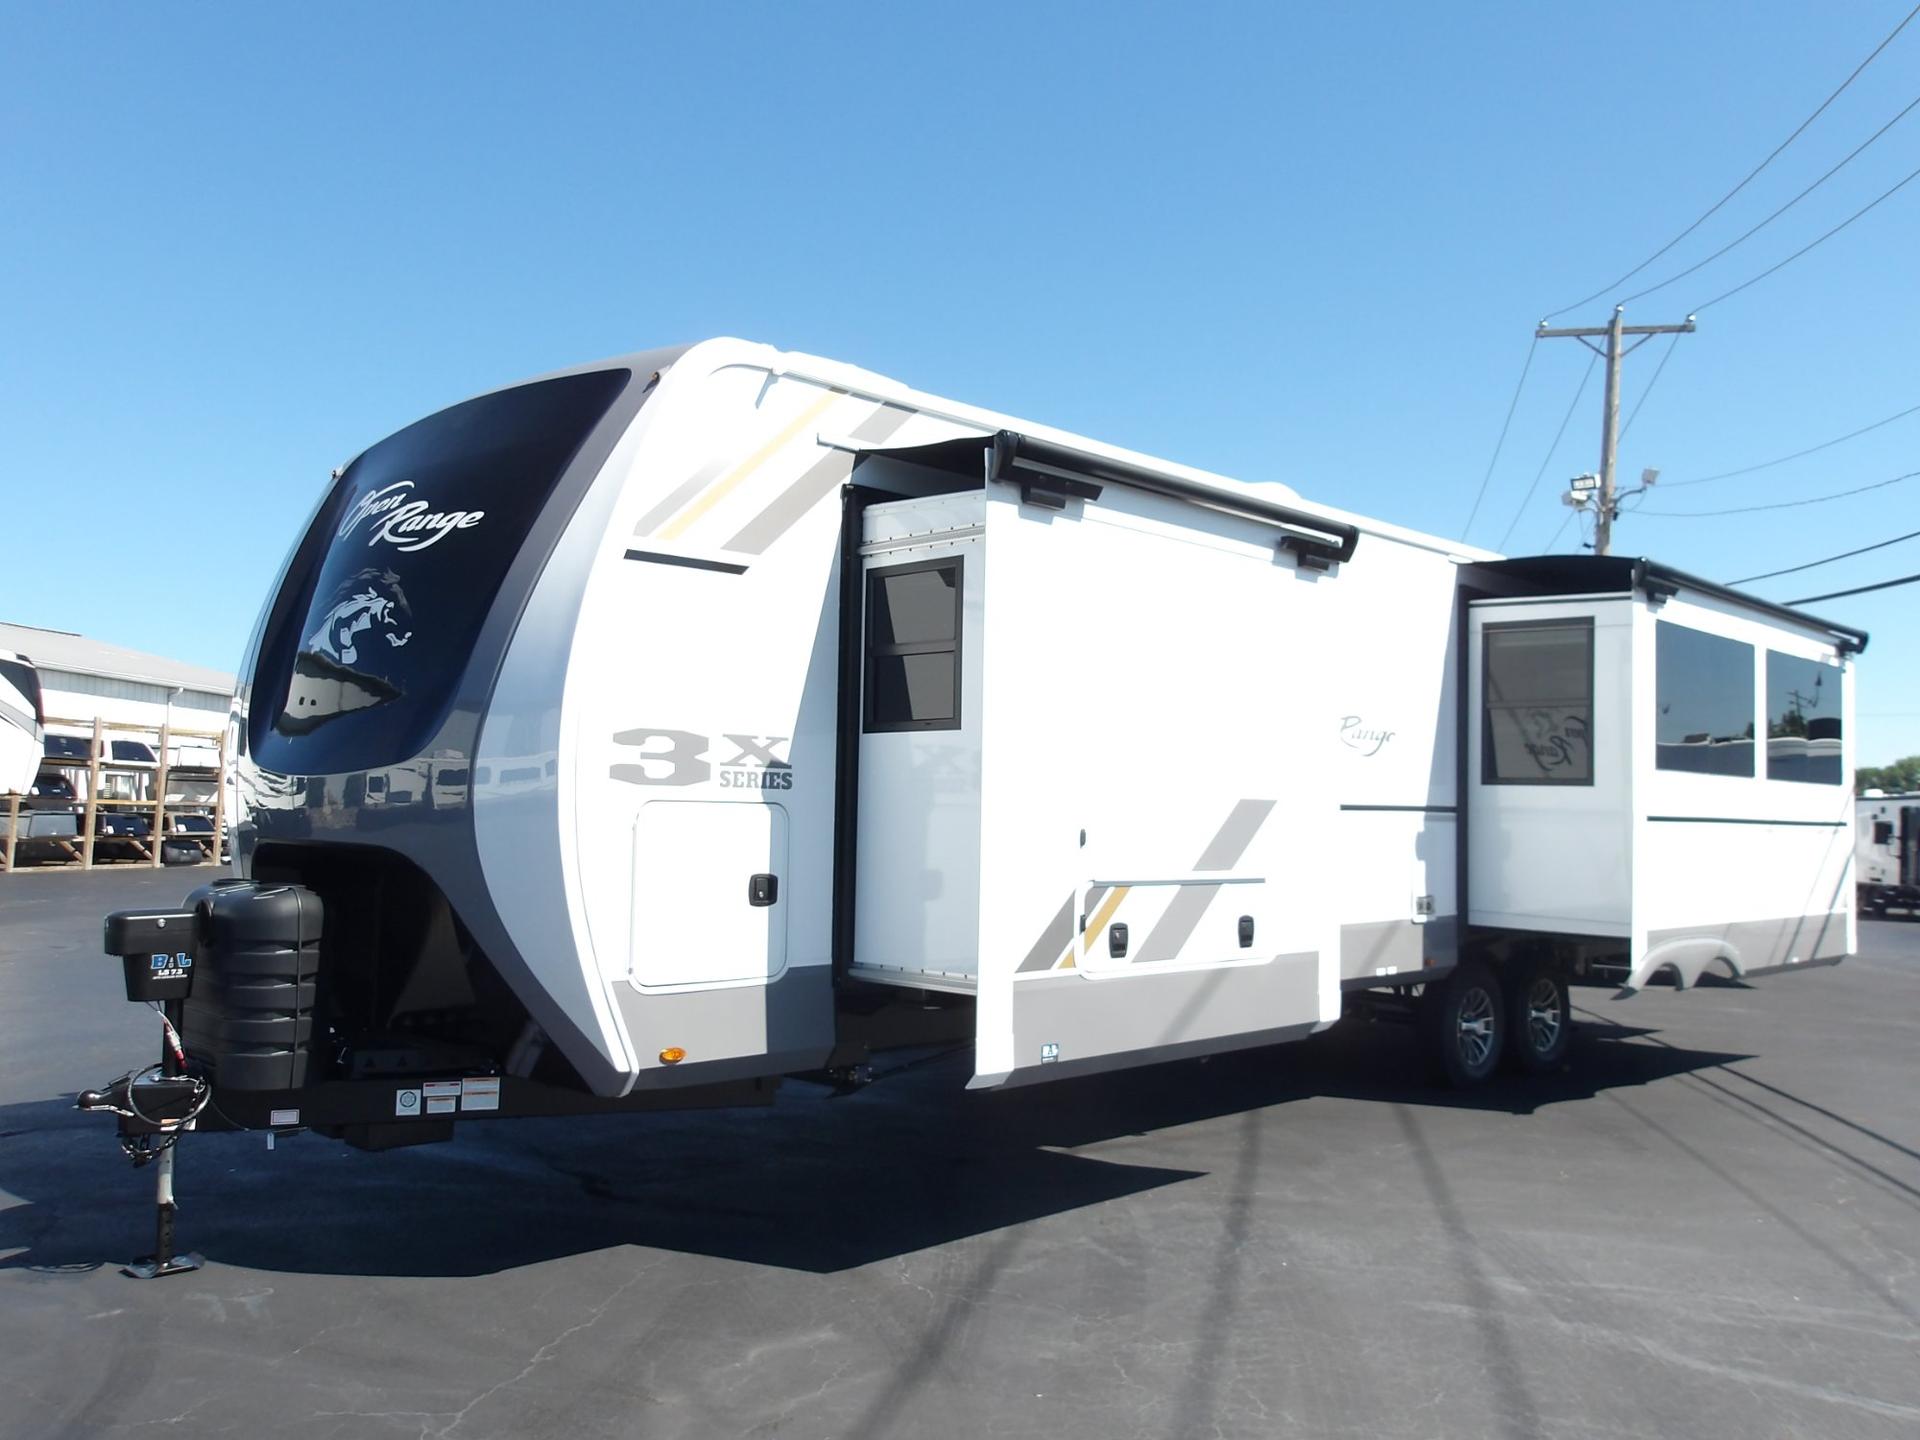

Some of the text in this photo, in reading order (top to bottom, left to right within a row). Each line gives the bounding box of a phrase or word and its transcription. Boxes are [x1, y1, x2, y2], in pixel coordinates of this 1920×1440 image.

[338, 480, 415, 542] Open
[368, 500, 485, 552] Range
[719, 770, 793, 790] SERIES
